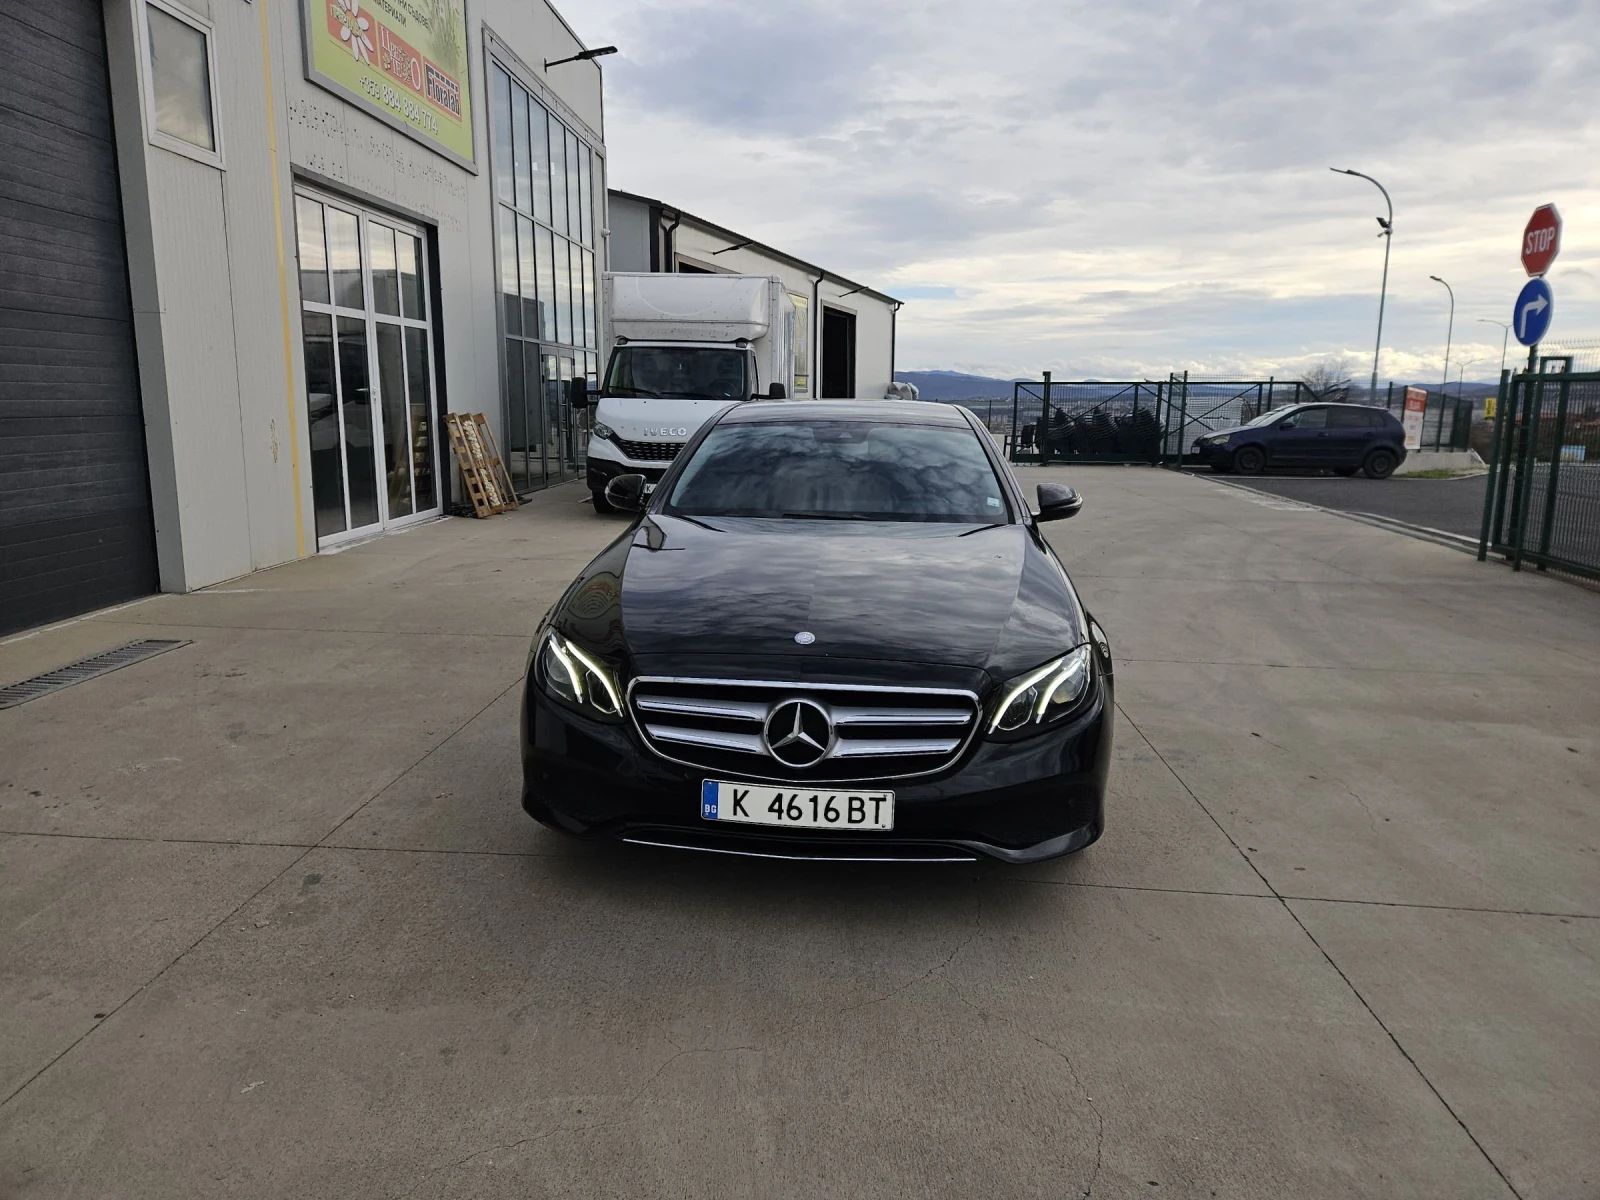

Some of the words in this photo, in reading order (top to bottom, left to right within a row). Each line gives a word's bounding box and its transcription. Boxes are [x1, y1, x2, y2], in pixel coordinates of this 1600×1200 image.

[425, 63, 460, 116] Floralab
[382, 84, 401, 112] 884
[403, 97, 420, 124] 884
[422, 109, 438, 135] 774
[1525, 226, 1556, 255] STOP
[643, 427, 687, 437] IVECO
[704, 804, 717, 814] BG
[732, 788, 750, 817] K
